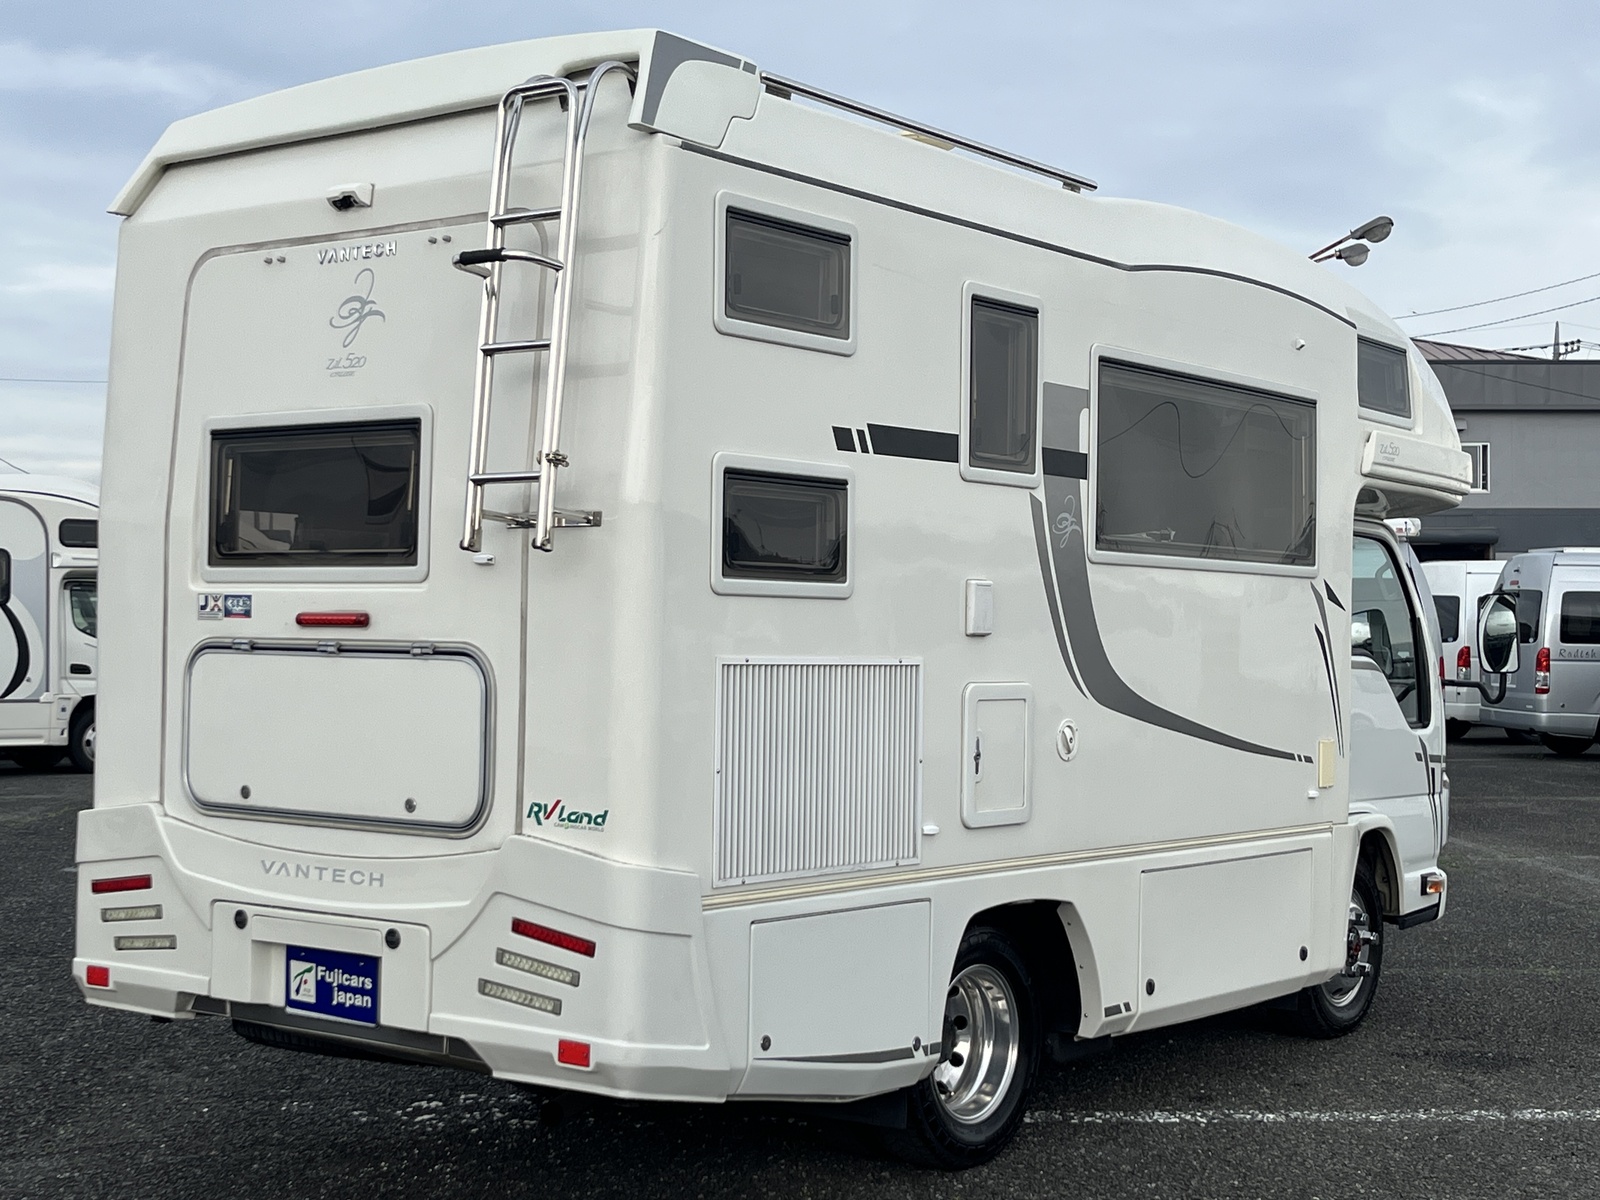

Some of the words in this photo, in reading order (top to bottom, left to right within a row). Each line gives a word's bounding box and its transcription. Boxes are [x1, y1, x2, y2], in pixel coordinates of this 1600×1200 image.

[317, 240, 398, 265] VANTECH
[526, 799, 562, 826] RV
[261, 859, 384, 888] VANTECH
[317, 965, 373, 990] Fujicars
[331, 986, 372, 1009] japan
